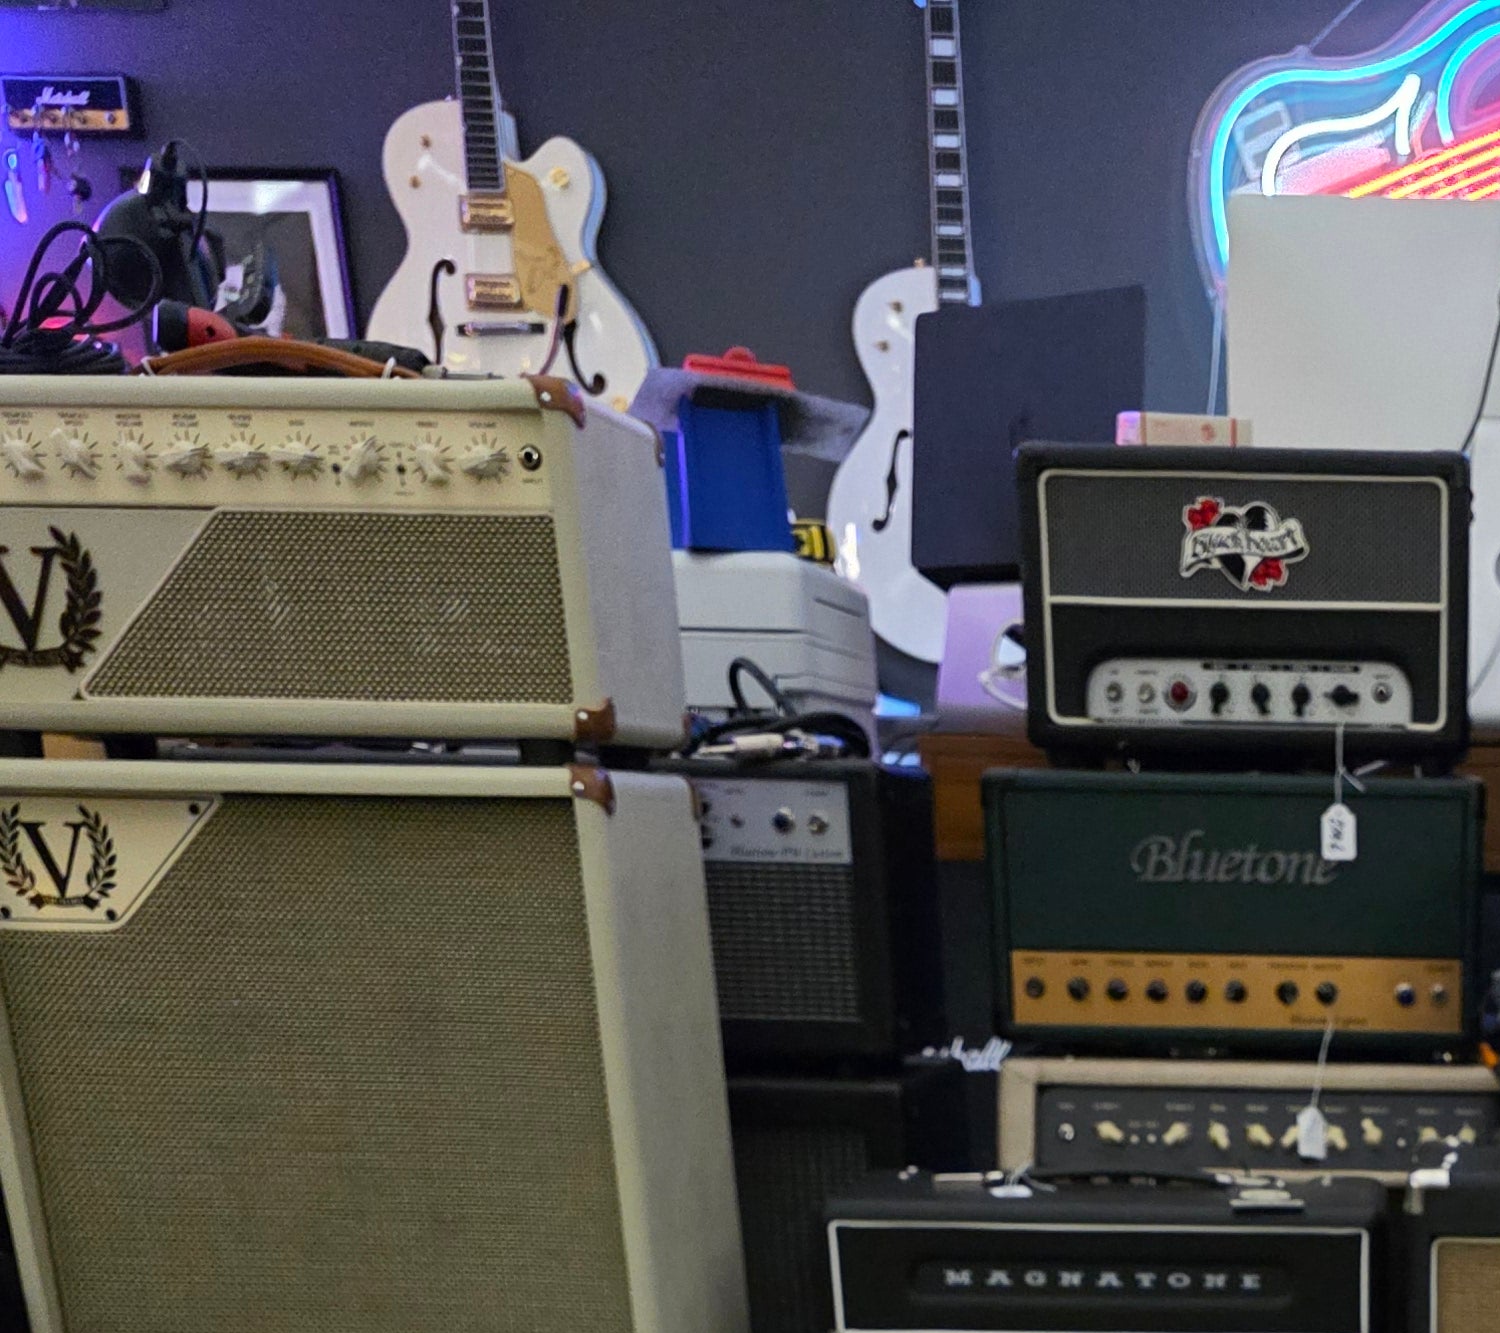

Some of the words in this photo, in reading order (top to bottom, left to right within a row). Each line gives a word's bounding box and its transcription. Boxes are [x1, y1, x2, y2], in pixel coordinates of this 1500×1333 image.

[21, 822, 84, 899] V
[1130, 828, 1338, 886] Bluetone
[945, 1269, 1261, 1288] MAGNATONE
